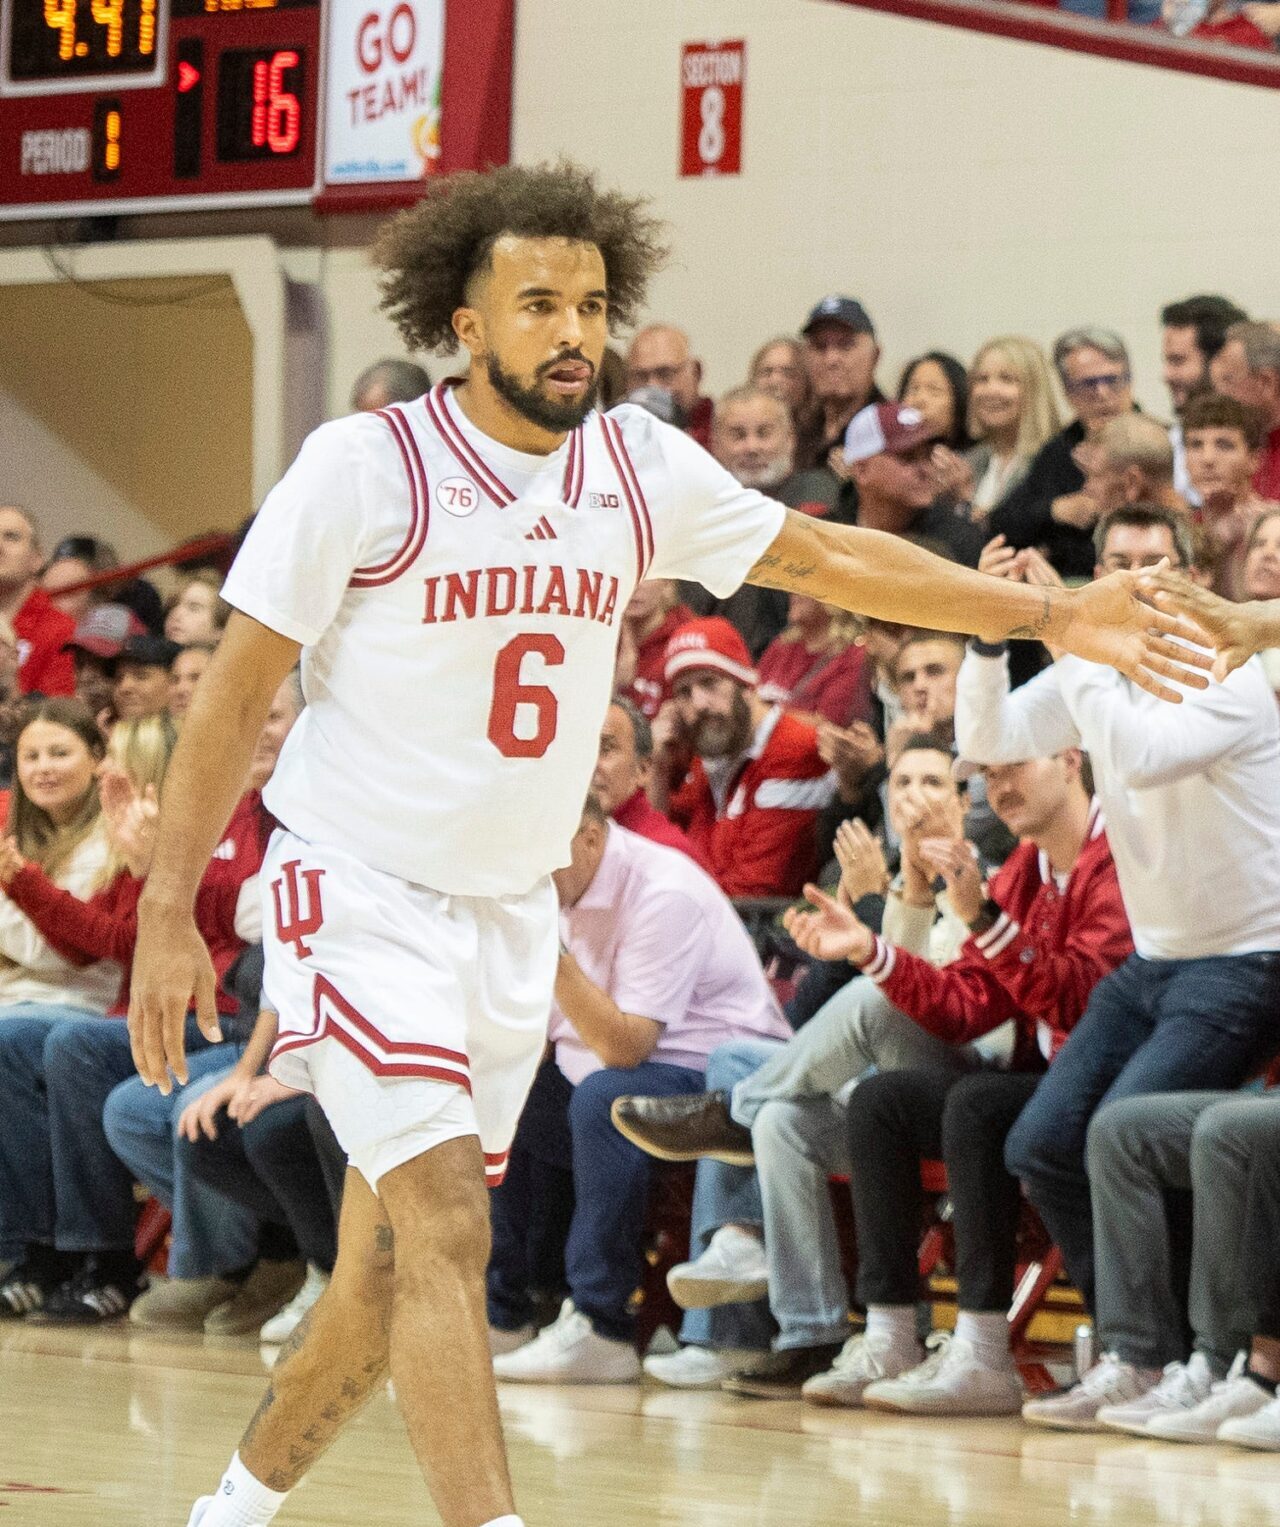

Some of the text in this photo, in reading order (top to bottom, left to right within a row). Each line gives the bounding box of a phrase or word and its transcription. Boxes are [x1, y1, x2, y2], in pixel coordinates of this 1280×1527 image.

[356, 3, 417, 73] GO
[346, 67, 427, 129] TEAM!
[682, 52, 742, 88] SECTION
[252, 51, 301, 153] 16
[698, 87, 725, 163] 8
[21, 128, 92, 175] PERIOD
[105, 111, 121, 170] 1
[422, 565, 619, 627] INDIANA
[487, 633, 565, 758] 6
